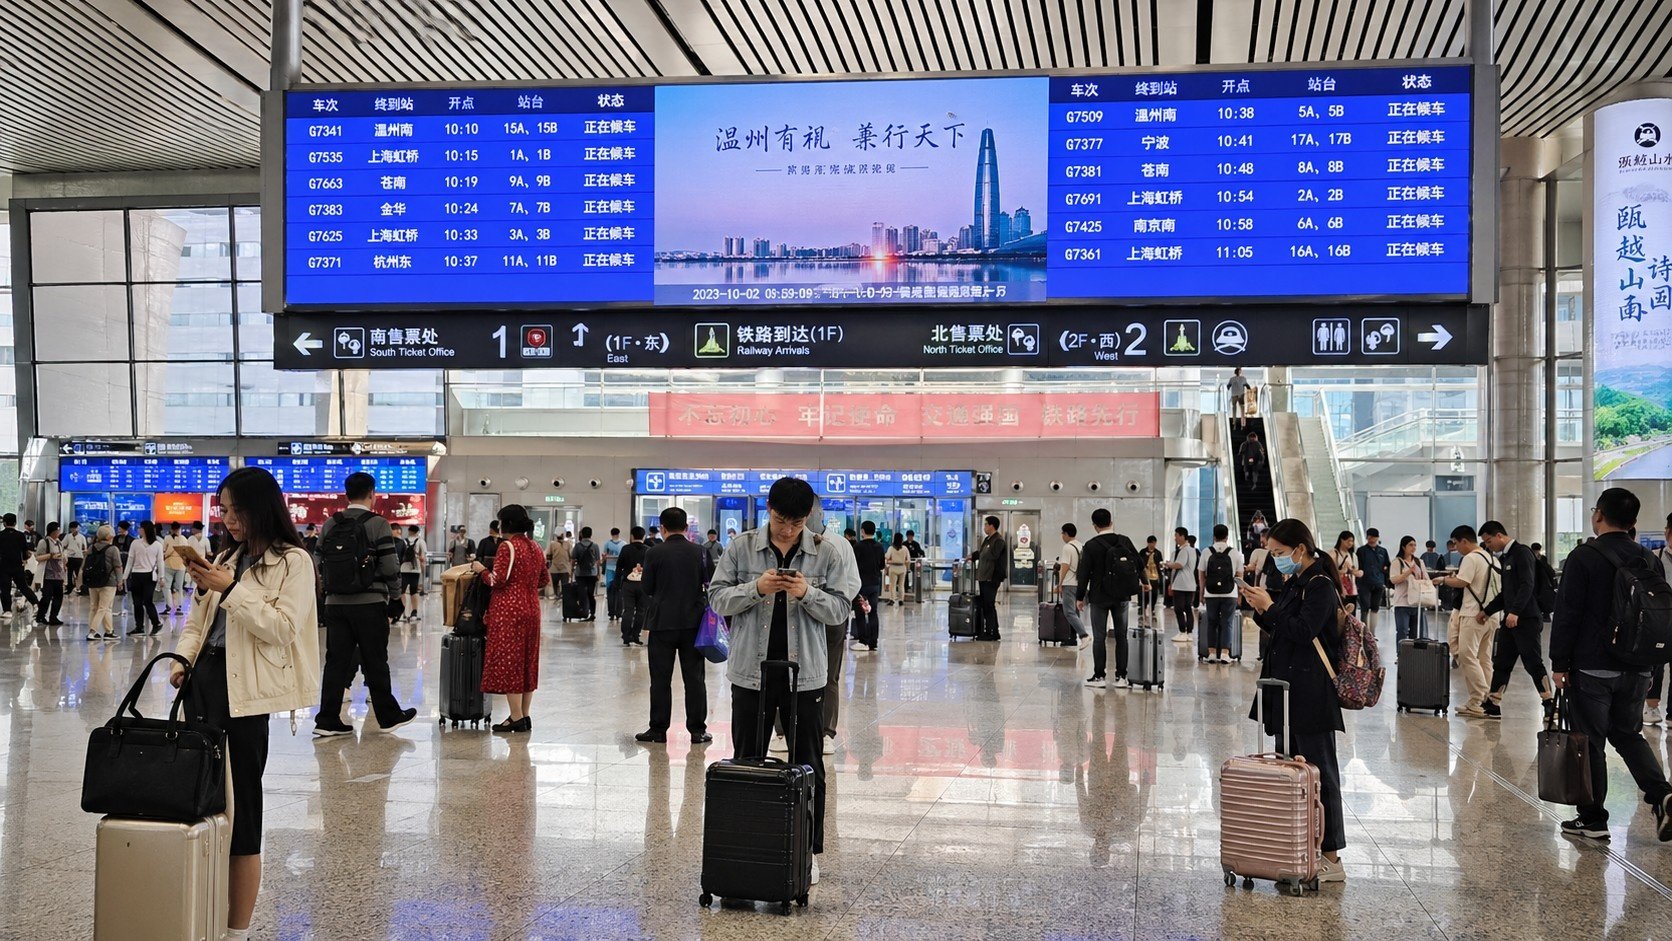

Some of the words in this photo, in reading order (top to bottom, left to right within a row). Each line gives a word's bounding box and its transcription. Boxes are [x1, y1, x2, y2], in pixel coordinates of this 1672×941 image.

[1070, 82, 1099, 98] 车次
[1135, 80, 1178, 96] 终到站
[1222, 78, 1250, 94] 开点
[1307, 76, 1336, 92] 站台
[1401, 73, 1432, 90] 状态
[312, 98, 339, 112] 车次
[374, 96, 414, 112] 终到站
[448, 95, 475, 110] 开点
[517, 94, 544, 109] 站台
[597, 92, 625, 108] 状态
[1066, 110, 1104, 123] G7509
[1218, 106, 1255, 120] 10:38
[1387, 100, 1446, 117] 正在候车
[309, 125, 342, 137] G7341
[444, 122, 479, 135] 10:10
[584, 119, 636, 134] 正在候车
[1065, 137, 1104, 151] G7377
[1141, 135, 1170, 151] 宁波
[1217, 134, 1253, 147] 10:41
[1387, 129, 1446, 145] 正在候车
[308, 151, 343, 164] G7535
[367, 149, 419, 164] 上海虹桥
[445, 149, 479, 162] 10:15
[583, 146, 636, 161] 正在候车
[1065, 165, 1101, 178] G7381
[1217, 162, 1254, 175] 10:48
[1387, 156, 1445, 173] 正在候车
[308, 177, 343, 190] G7663
[444, 175, 478, 188] 10:19
[583, 172, 636, 187] 正在候车
[1065, 193, 1101, 206] G7691
[1126, 190, 1183, 206] 上海虹桥
[1217, 190, 1254, 203] 10:54
[1386, 185, 1445, 201] 正在候车
[308, 204, 343, 216] G7383
[380, 202, 407, 216] 金华
[444, 202, 479, 214] 10:24
[583, 199, 636, 214] 正在候车
[1065, 220, 1102, 233] G7425
[1133, 217, 1176, 233] 南京南
[1217, 218, 1254, 231] 10:58
[1386, 213, 1445, 229] 正在候车
[308, 230, 343, 242] G7625
[367, 228, 419, 243] 上海虹桥
[444, 228, 478, 241] 10:33
[583, 225, 635, 241] 正在候车
[308, 256, 341, 269] G7371
[373, 254, 412, 269] 杭州东
[444, 255, 478, 267] 10:37
[582, 252, 635, 267] 正在候车
[1064, 248, 1101, 261] G7361
[1126, 245, 1183, 261] 上海虹桥
[1216, 245, 1253, 259] 11:05
[1386, 241, 1445, 257] 正在候车
[692, 288, 760, 300] 2023-10-02
[369, 327, 439, 346] 南售票处
[492, 325, 507, 359] 1
[736, 324, 844, 344] 铁路到达(1F)
[930, 324, 1003, 343] 北售票处
[1124, 322, 1147, 356] 2
[369, 347, 396, 357] South
[398, 347, 426, 357] Ticket
[428, 347, 455, 357] Office
[607, 353, 629, 363] East
[737, 345, 773, 357] Railway
[775, 345, 810, 355] Arrivals
[923, 345, 948, 354] North
[949, 344, 976, 354] Ticket
[977, 344, 1004, 354] Office
[1094, 350, 1119, 361] West
